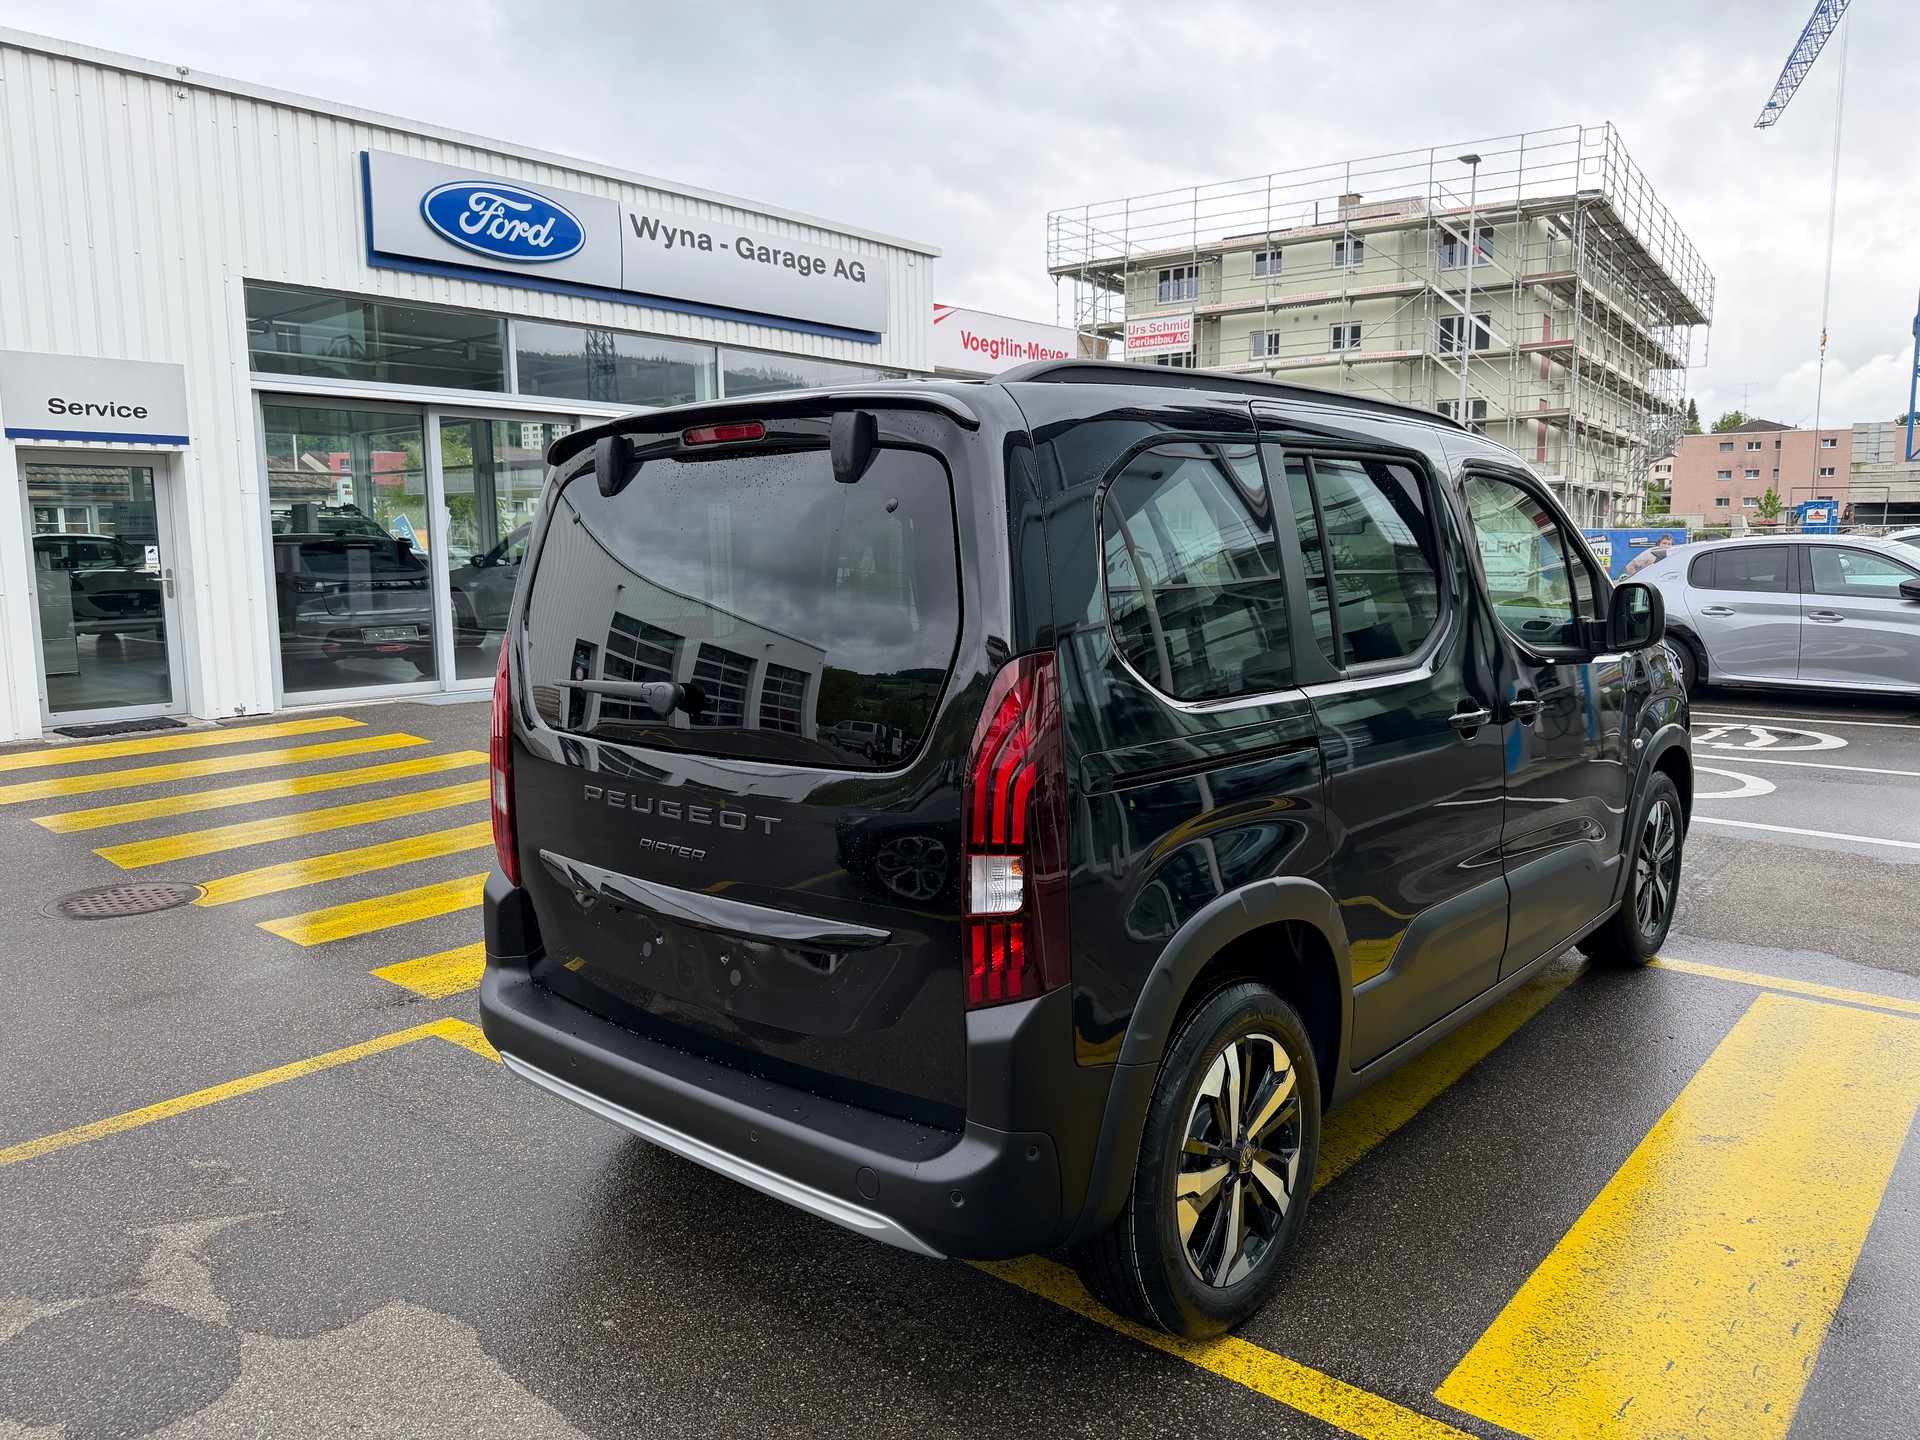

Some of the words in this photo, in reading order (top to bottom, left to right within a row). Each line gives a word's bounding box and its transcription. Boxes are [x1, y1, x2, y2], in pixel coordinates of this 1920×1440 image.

[459, 192, 556, 248] Ford
[629, 213, 713, 252] Wyna
[735, 236, 827, 277] Garage
[833, 258, 867, 284] AG
[1128, 325, 1147, 335] Urs
[1149, 319, 1190, 334] Schmid
[1128, 335, 1174, 348] Gerüstbau
[1175, 332, 1189, 342] AG
[961, 330, 1069, 360] Voegtlin-Meyer
[48, 398, 148, 419] Service
[584, 785, 783, 835] PEUGEOT
[639, 838, 706, 861] RIFTER
